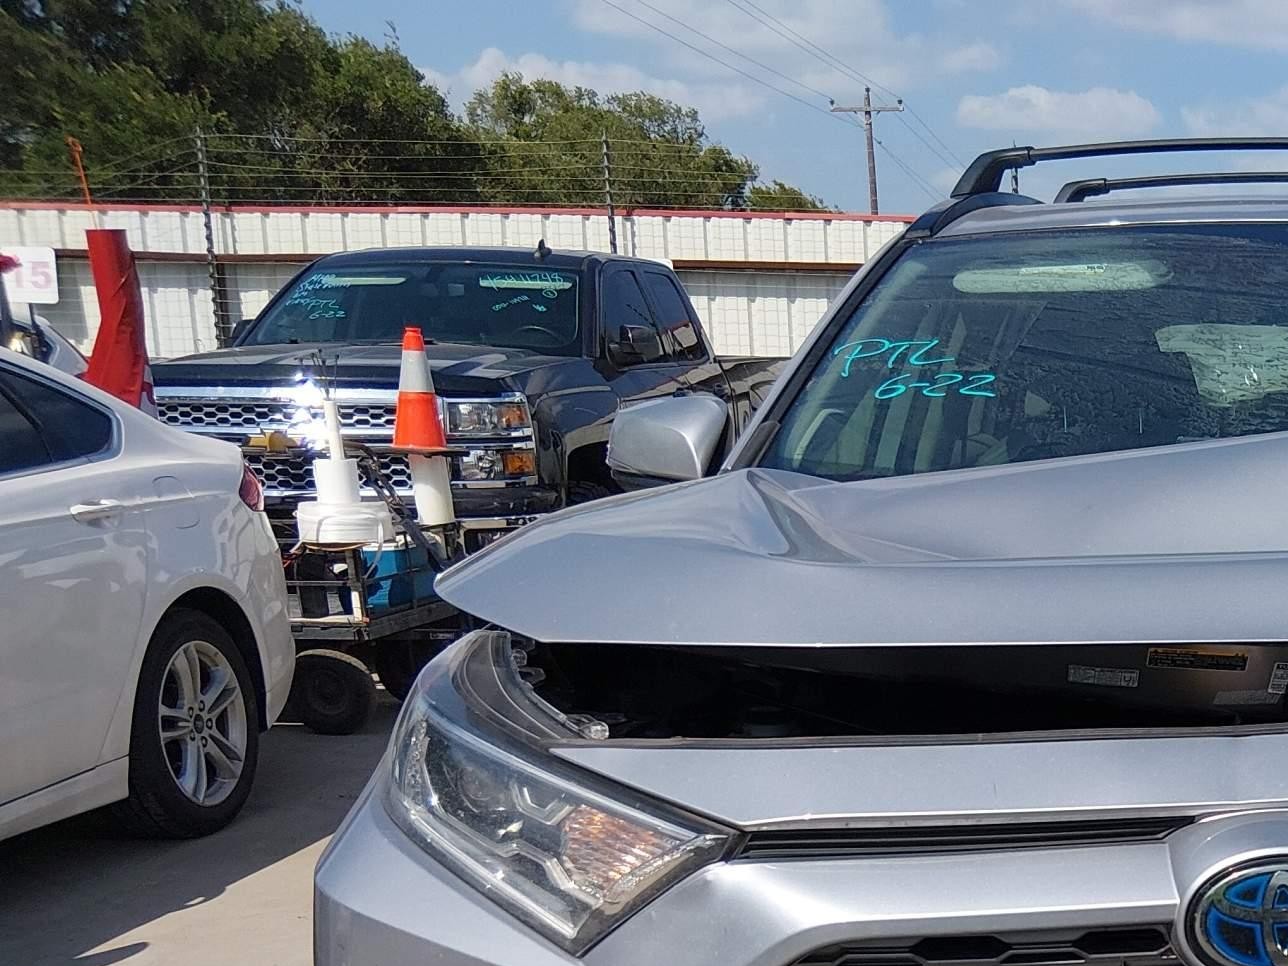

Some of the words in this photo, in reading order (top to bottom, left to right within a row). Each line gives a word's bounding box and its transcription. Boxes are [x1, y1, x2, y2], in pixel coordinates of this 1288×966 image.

[15, 261, 53, 290] 15
[834, 338, 955, 378] PTL
[874, 373, 997, 400] 6-22
